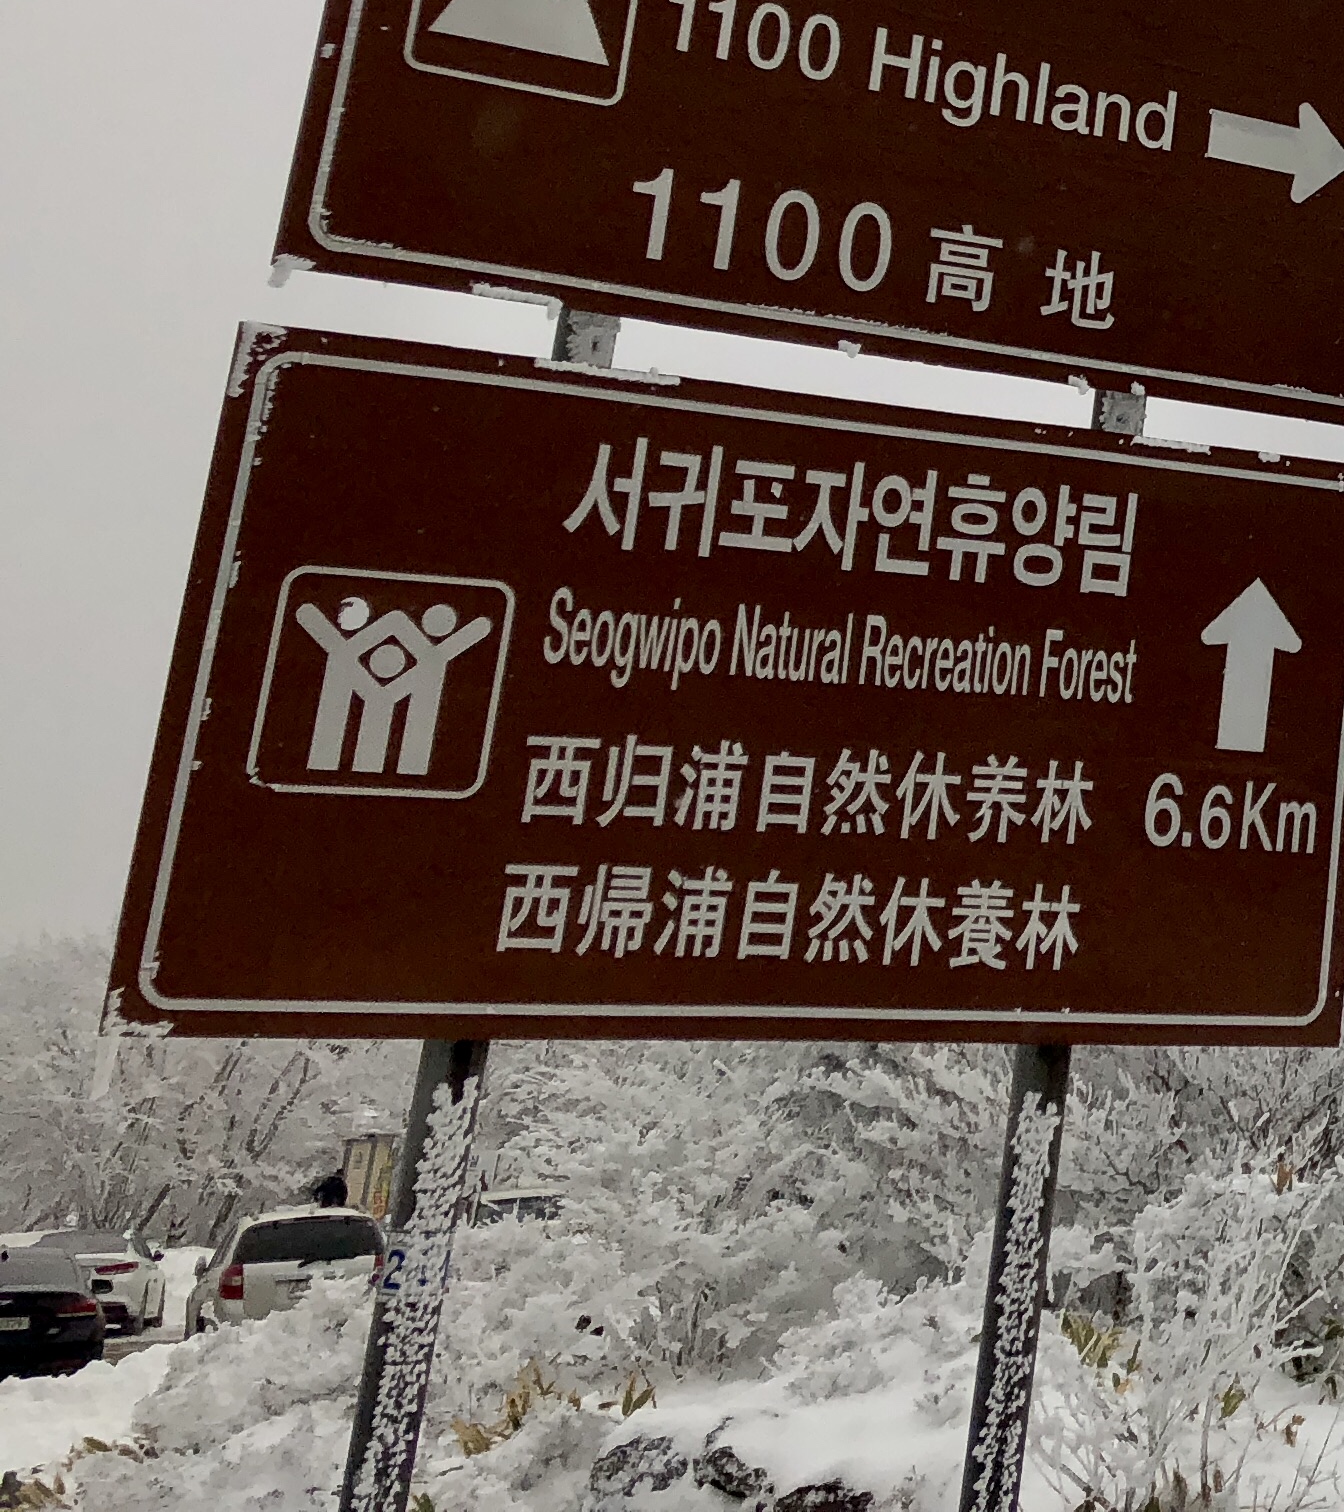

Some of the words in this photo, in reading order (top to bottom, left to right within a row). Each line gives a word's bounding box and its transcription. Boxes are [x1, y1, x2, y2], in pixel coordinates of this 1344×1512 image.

[868, 26, 1178, 152] Highland
[632, 167, 892, 292] 1100
[562, 436, 1139, 598] 서귀포자연휴양림
[543, 586, 722, 691] Seogwipo
[728, 603, 854, 685] Natural
[858, 614, 1031, 696] Recreation
[1038, 628, 1138, 704] Forest
[520, 734, 1094, 845] 西归浦自然休养林
[1144, 772, 1317, 854] 6.6Km
[495, 863, 1081, 971] 西帰浦自然休養林
